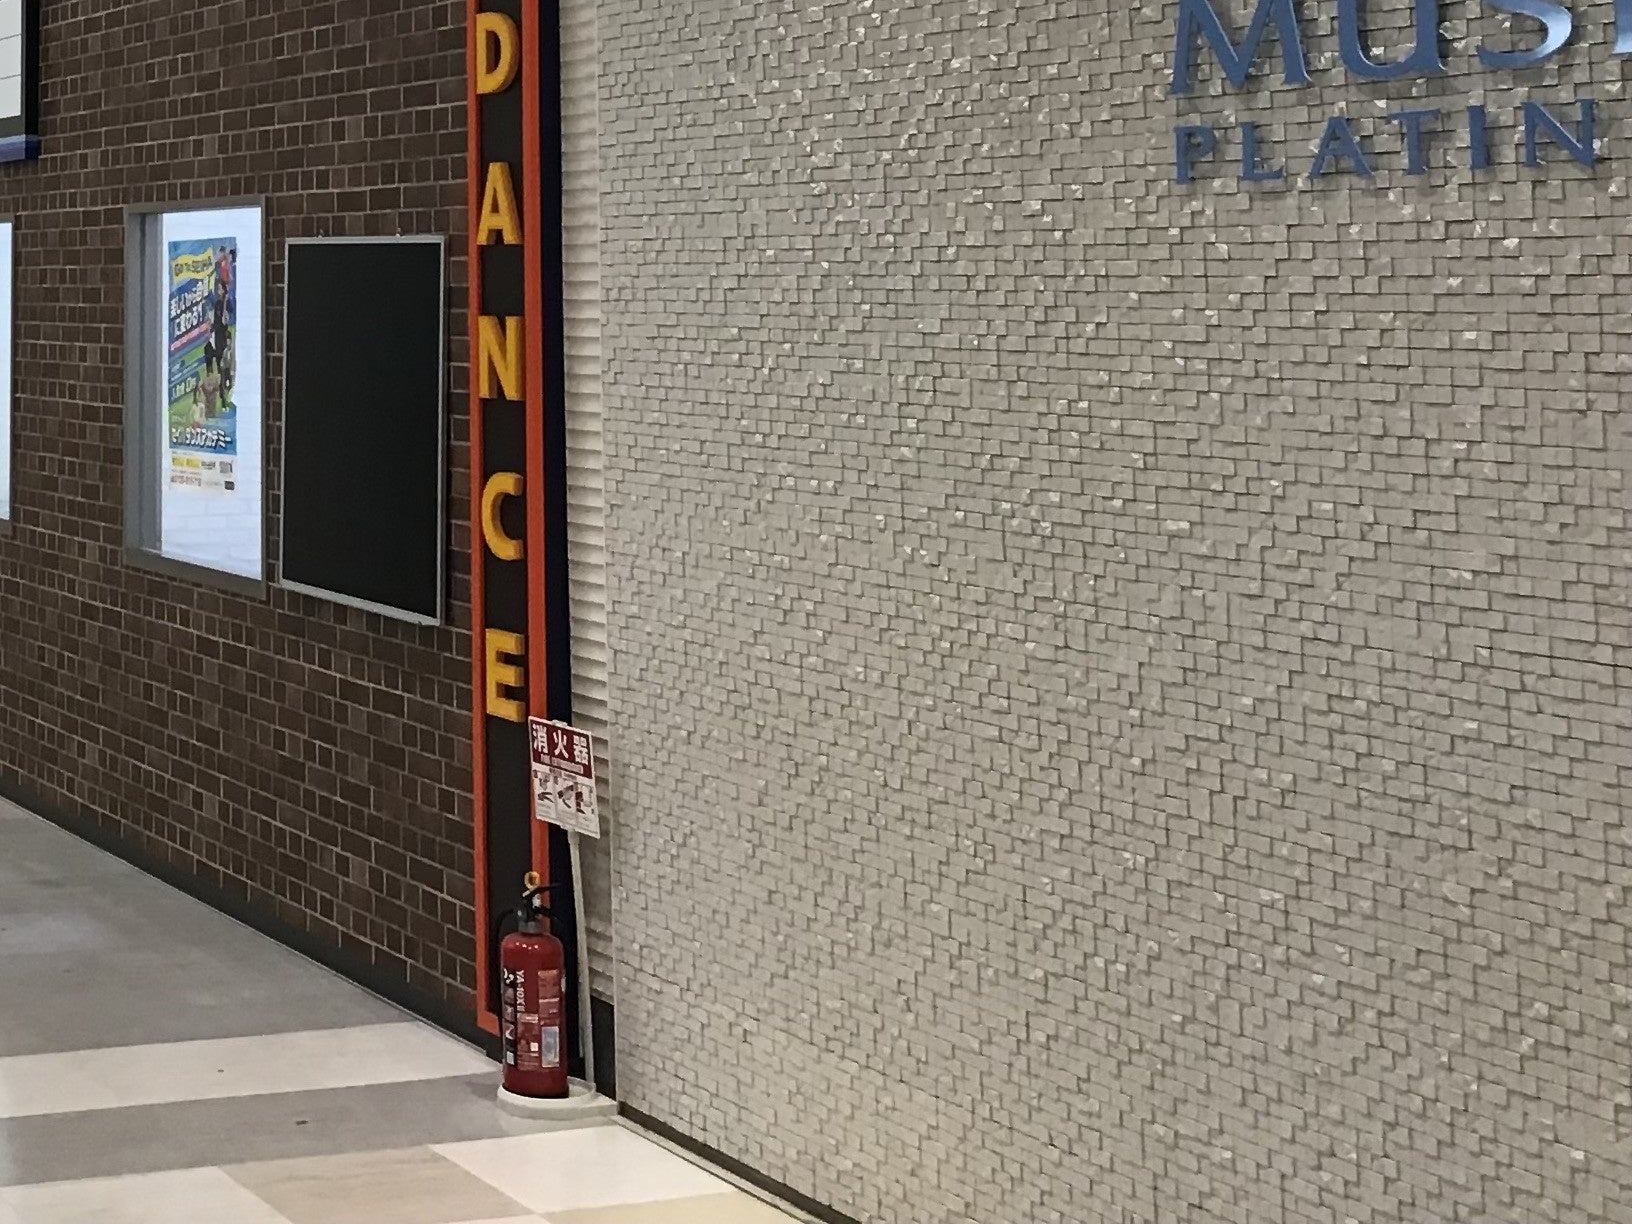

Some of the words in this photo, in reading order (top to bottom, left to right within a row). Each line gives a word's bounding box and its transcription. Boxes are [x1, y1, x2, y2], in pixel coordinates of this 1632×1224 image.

[1174, 98, 1598, 185] PLATIN
[474, 10, 524, 725] DANCE
[532, 723, 589, 766] 消火器
